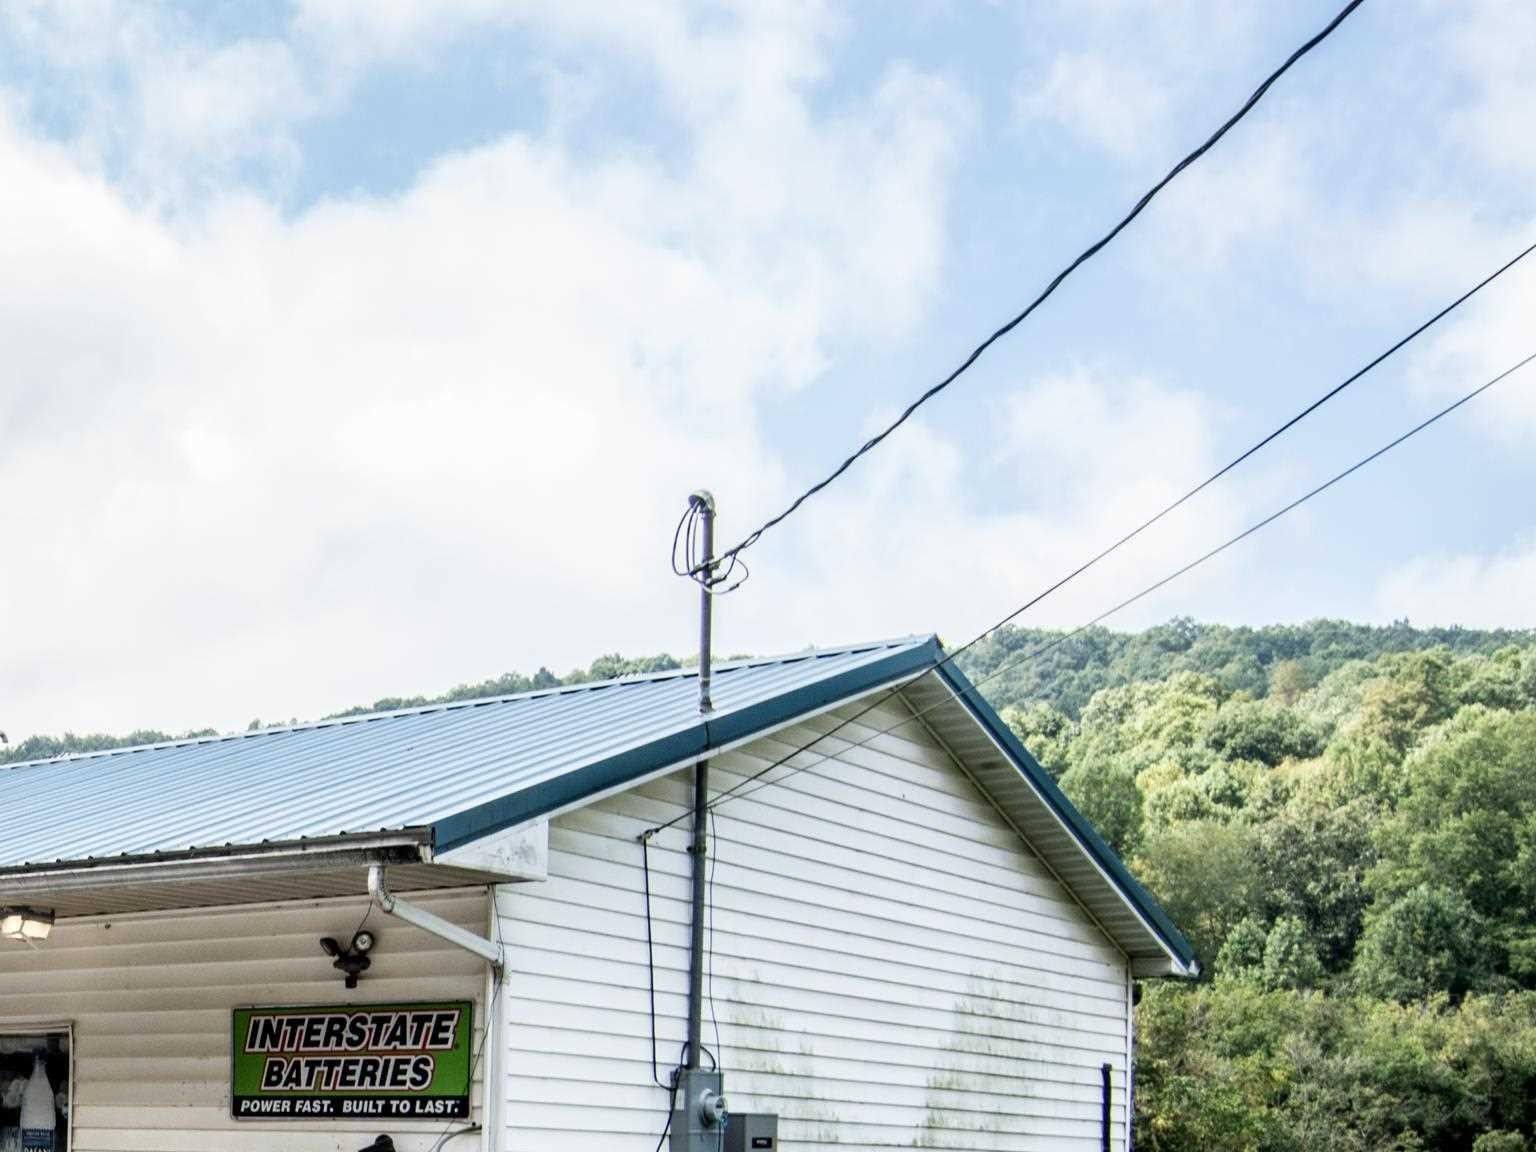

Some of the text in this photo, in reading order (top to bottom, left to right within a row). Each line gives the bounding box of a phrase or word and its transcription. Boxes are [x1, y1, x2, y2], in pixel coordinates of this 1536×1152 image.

[246, 1010, 460, 1052] INTERSTATE
[261, 1055, 434, 1091] BATTERIES
[240, 1100, 459, 1113] POWER FAST. BUILT TO LAST.
